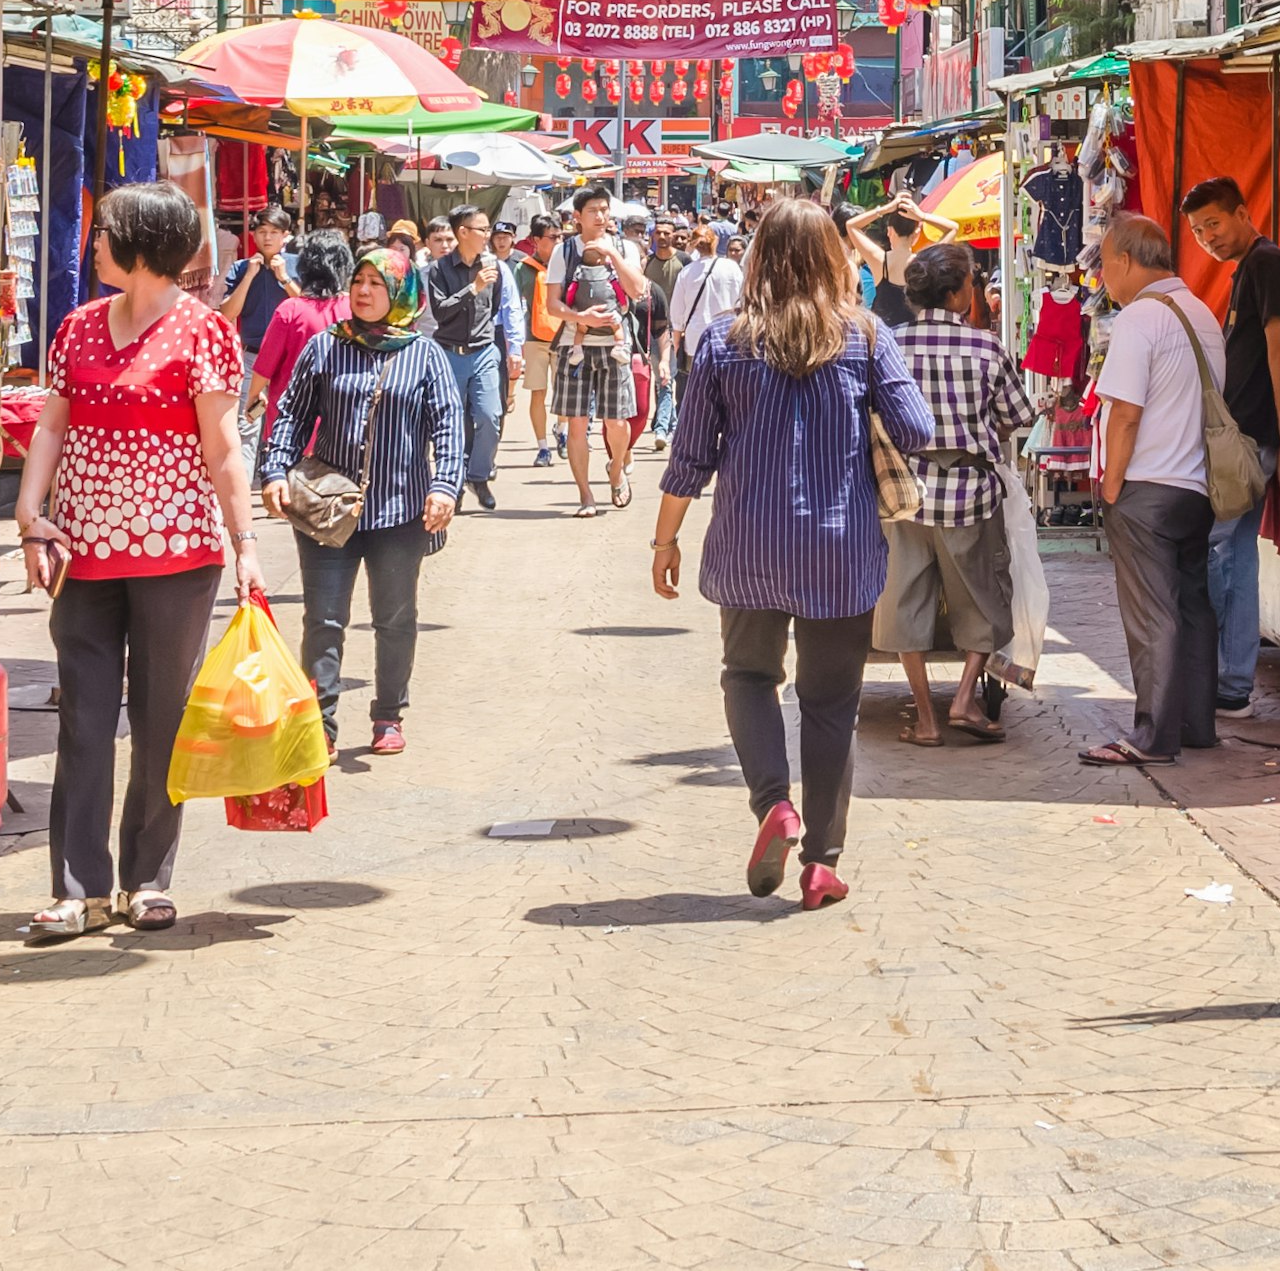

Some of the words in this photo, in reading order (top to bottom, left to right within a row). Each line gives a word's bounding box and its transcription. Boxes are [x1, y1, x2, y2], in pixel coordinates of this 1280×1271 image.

[340, 9, 442, 31] CHINAOWN
[566, 0, 599, 17] FOR
[606, 3, 716, 20] PRE-ORDERS,
[565, 22, 583, 37] 03
[586, 22, 620, 38] 2072
[623, 24, 658, 40] 8888
[661, 24, 695, 40] (TEL)
[704, 23, 730, 38] 012
[733, 20, 760, 36] 886
[763, 18, 797, 34] 8321
[800, 14, 832, 32] (HP)
[725, 37, 807, 52] www.fungwong.my
[573, 120, 657, 155] KK
